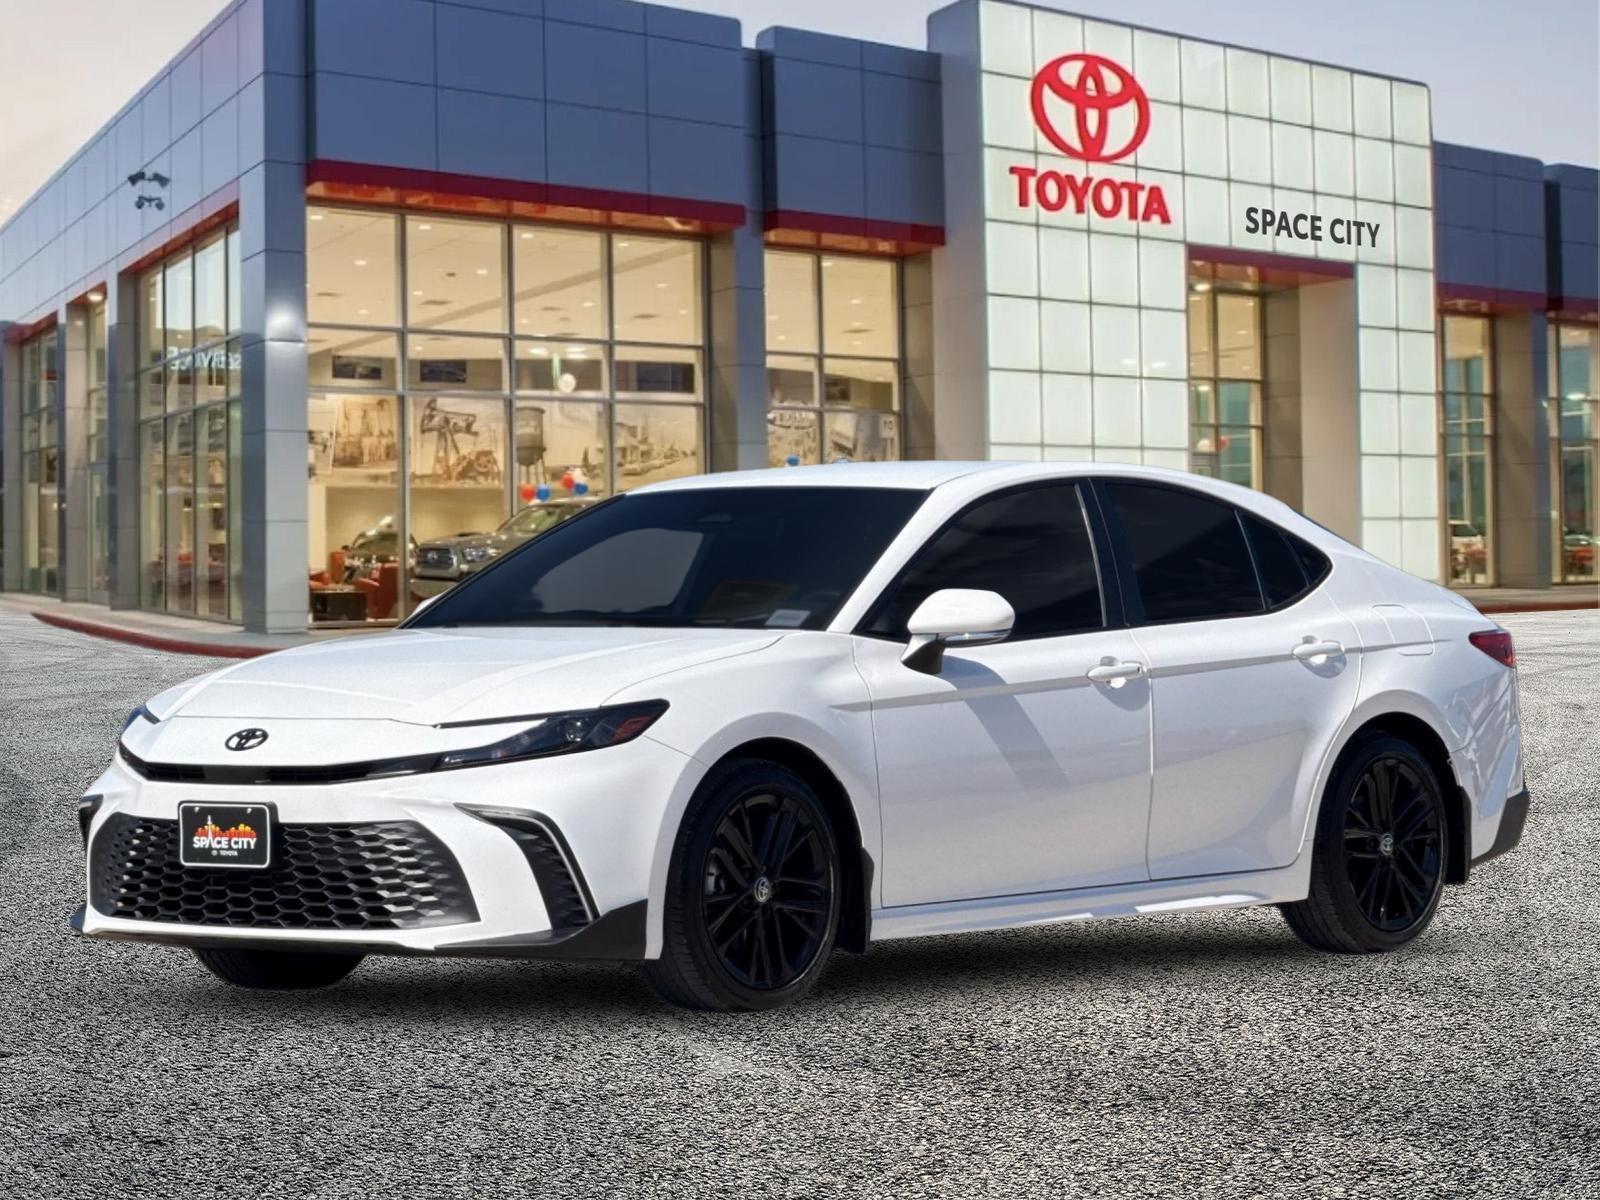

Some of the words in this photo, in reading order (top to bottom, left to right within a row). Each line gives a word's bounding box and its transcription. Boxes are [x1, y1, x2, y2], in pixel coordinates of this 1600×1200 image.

[1009, 166, 1171, 224] TOYOTA
[1245, 206, 1322, 241] SPACE
[1330, 218, 1380, 248] CITY
[193, 836, 229, 849] SPACE
[231, 838, 257, 850] CITY
